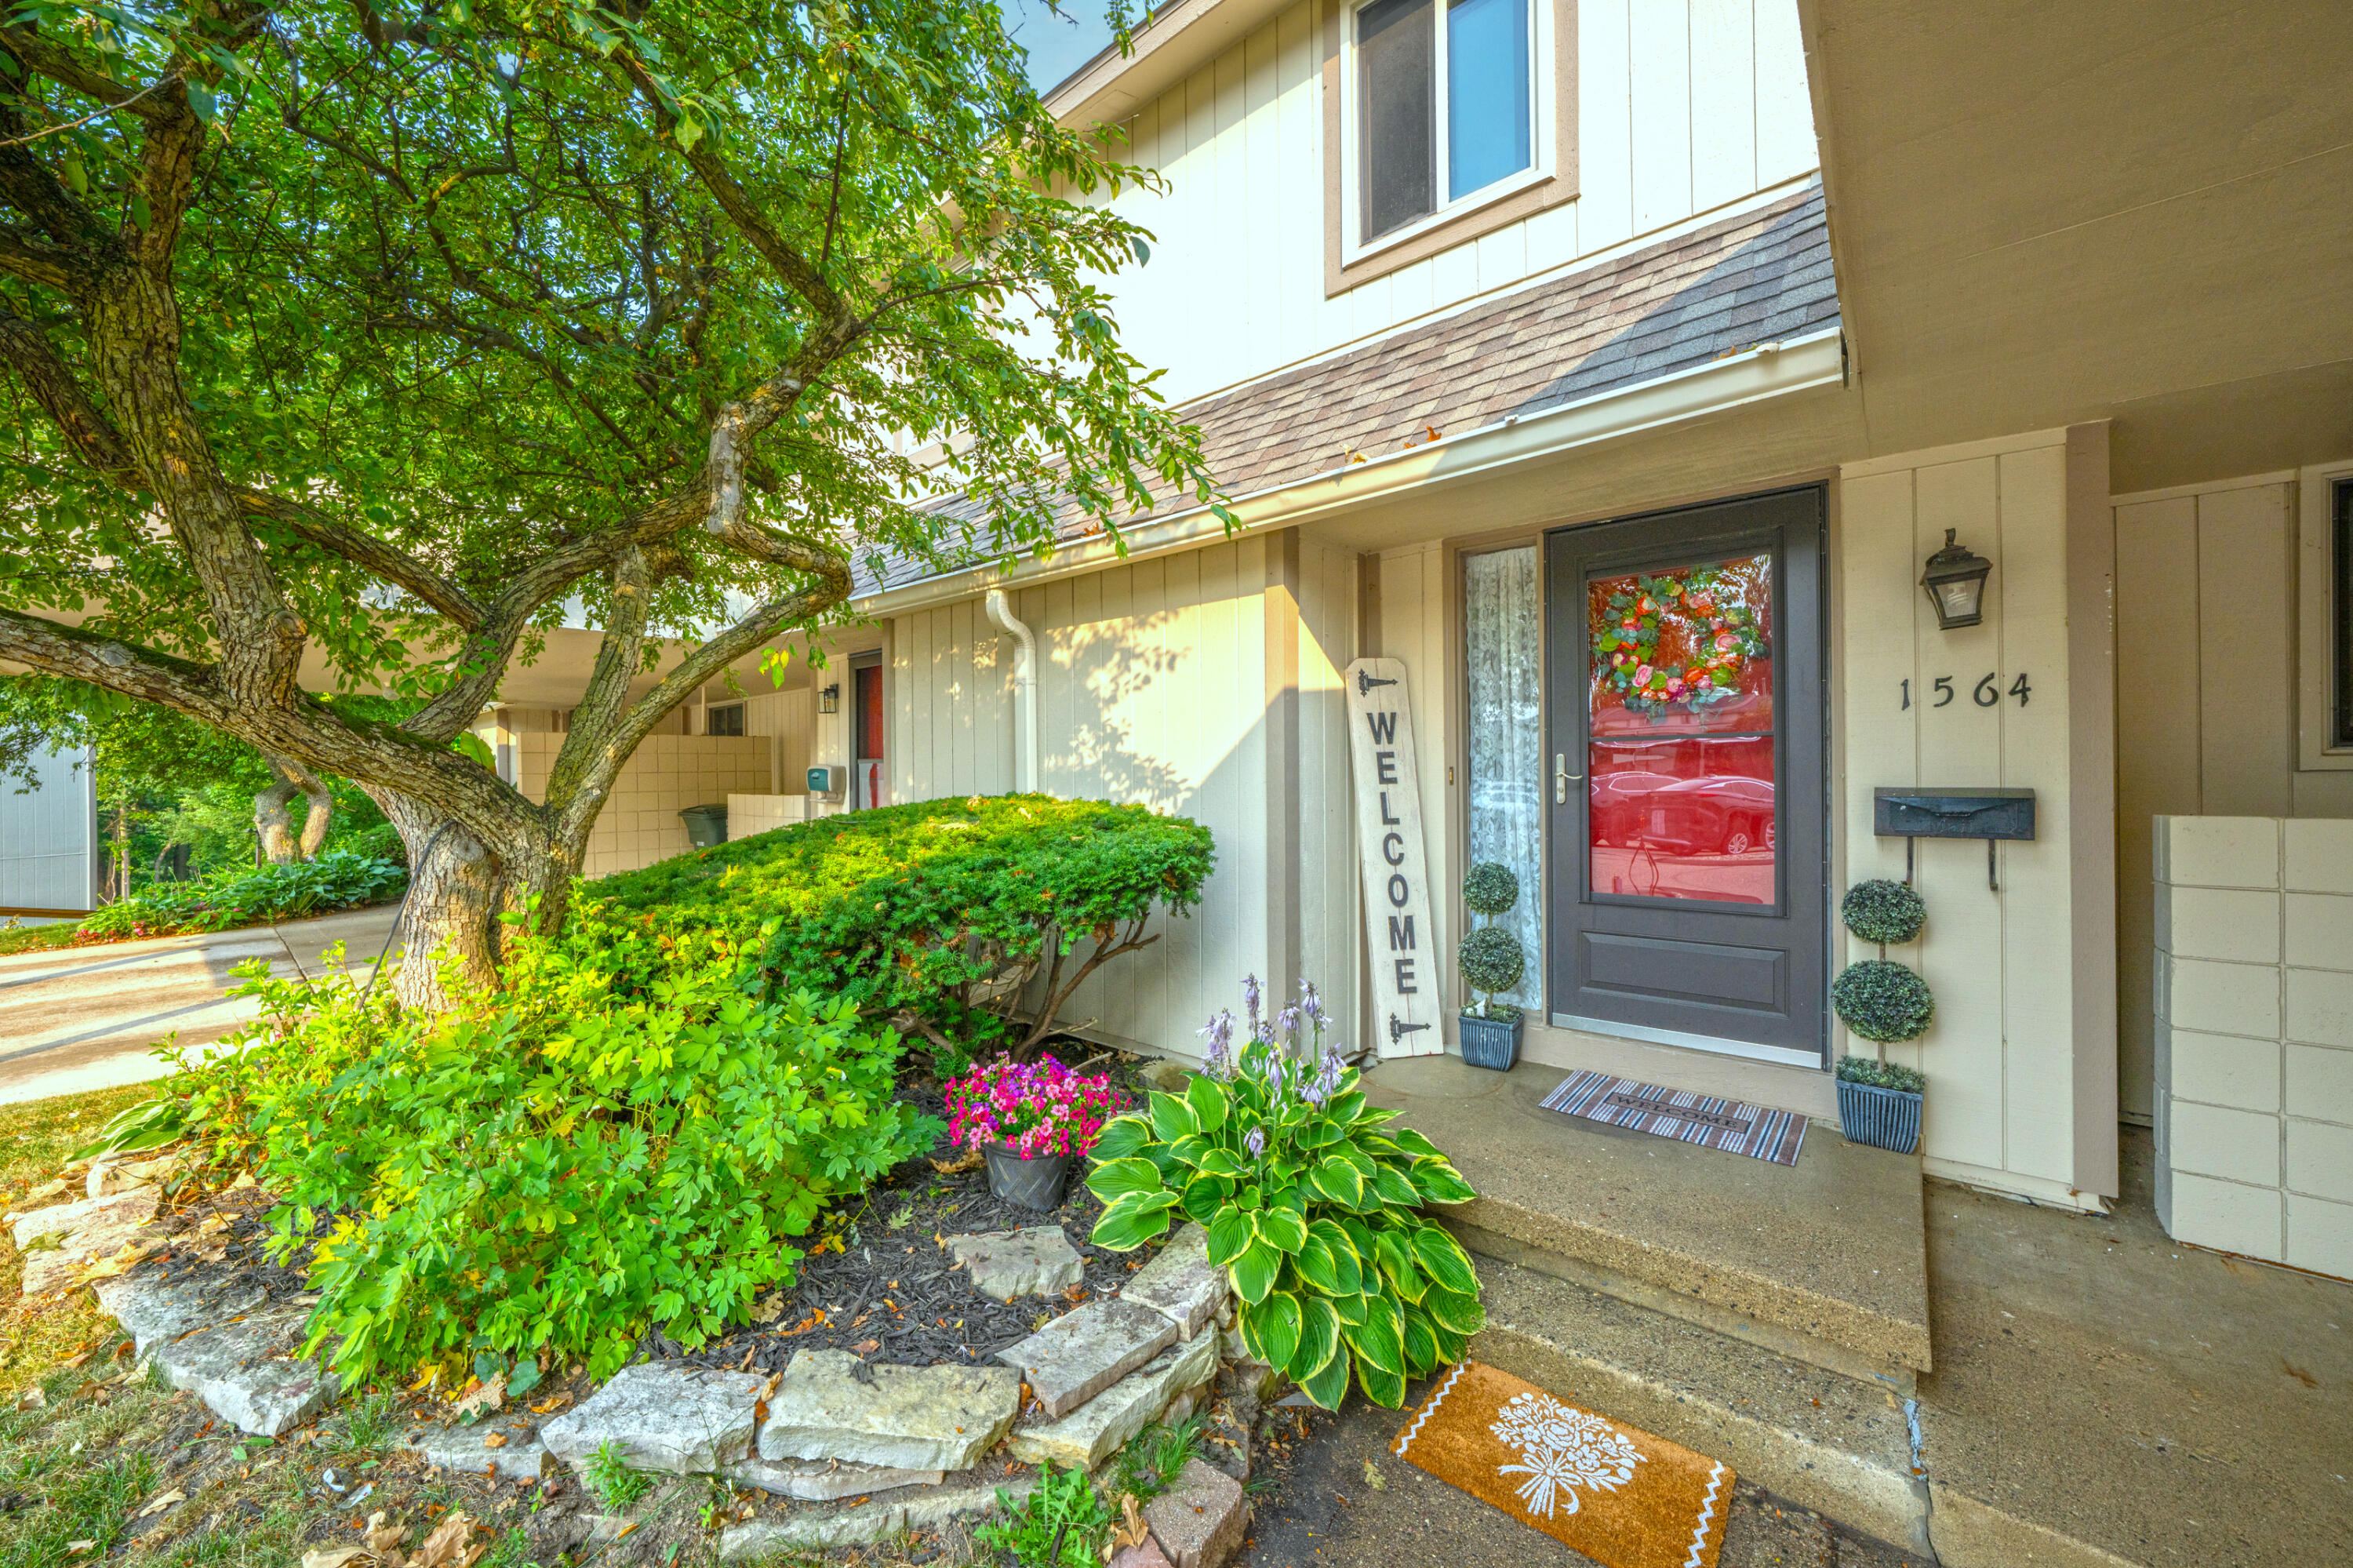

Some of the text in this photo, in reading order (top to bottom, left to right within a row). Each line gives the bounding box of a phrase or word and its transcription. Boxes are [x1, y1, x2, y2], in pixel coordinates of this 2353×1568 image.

[1900, 672, 2032, 711] 1564
[1366, 711, 1417, 995] WELCOME
[1617, 1096, 1738, 1130] WELCOME
